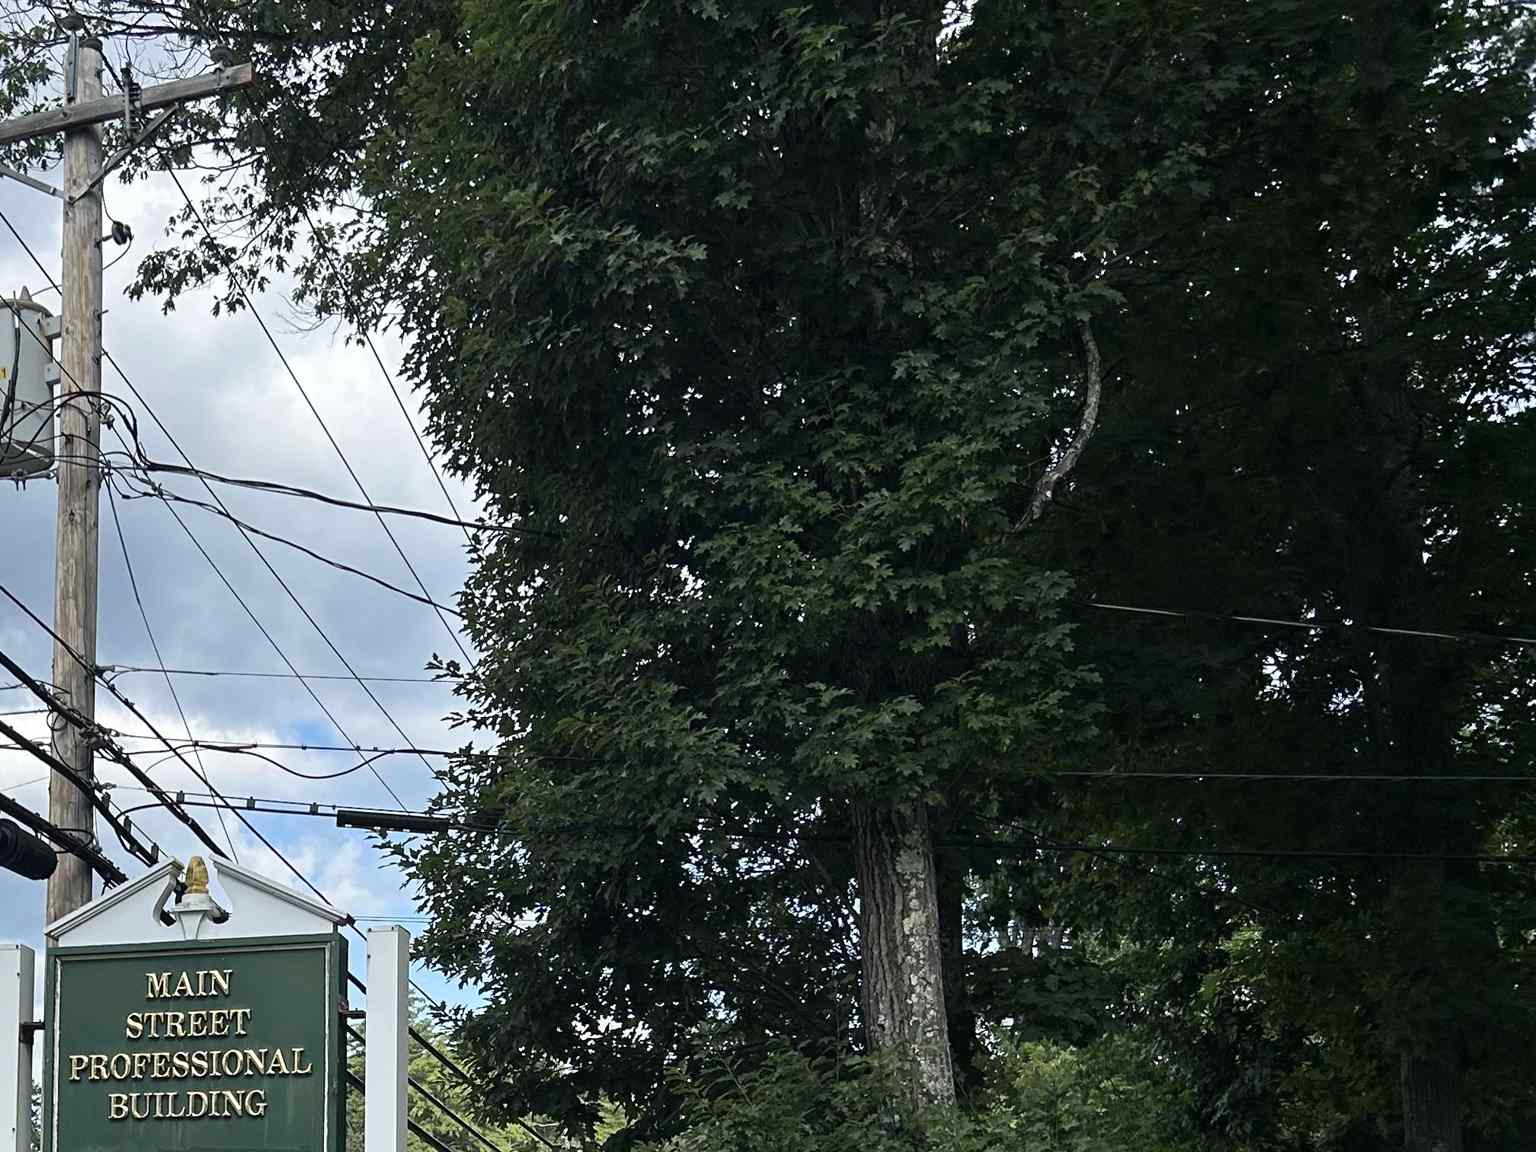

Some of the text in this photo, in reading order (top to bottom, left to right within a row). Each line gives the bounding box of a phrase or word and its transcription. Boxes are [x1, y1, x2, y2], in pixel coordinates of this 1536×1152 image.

[145, 969, 232, 999] MAIN
[126, 1009, 251, 1039] STREET
[69, 1048, 312, 1081] PROFESSIONAL
[108, 1089, 267, 1120] BUILDING
